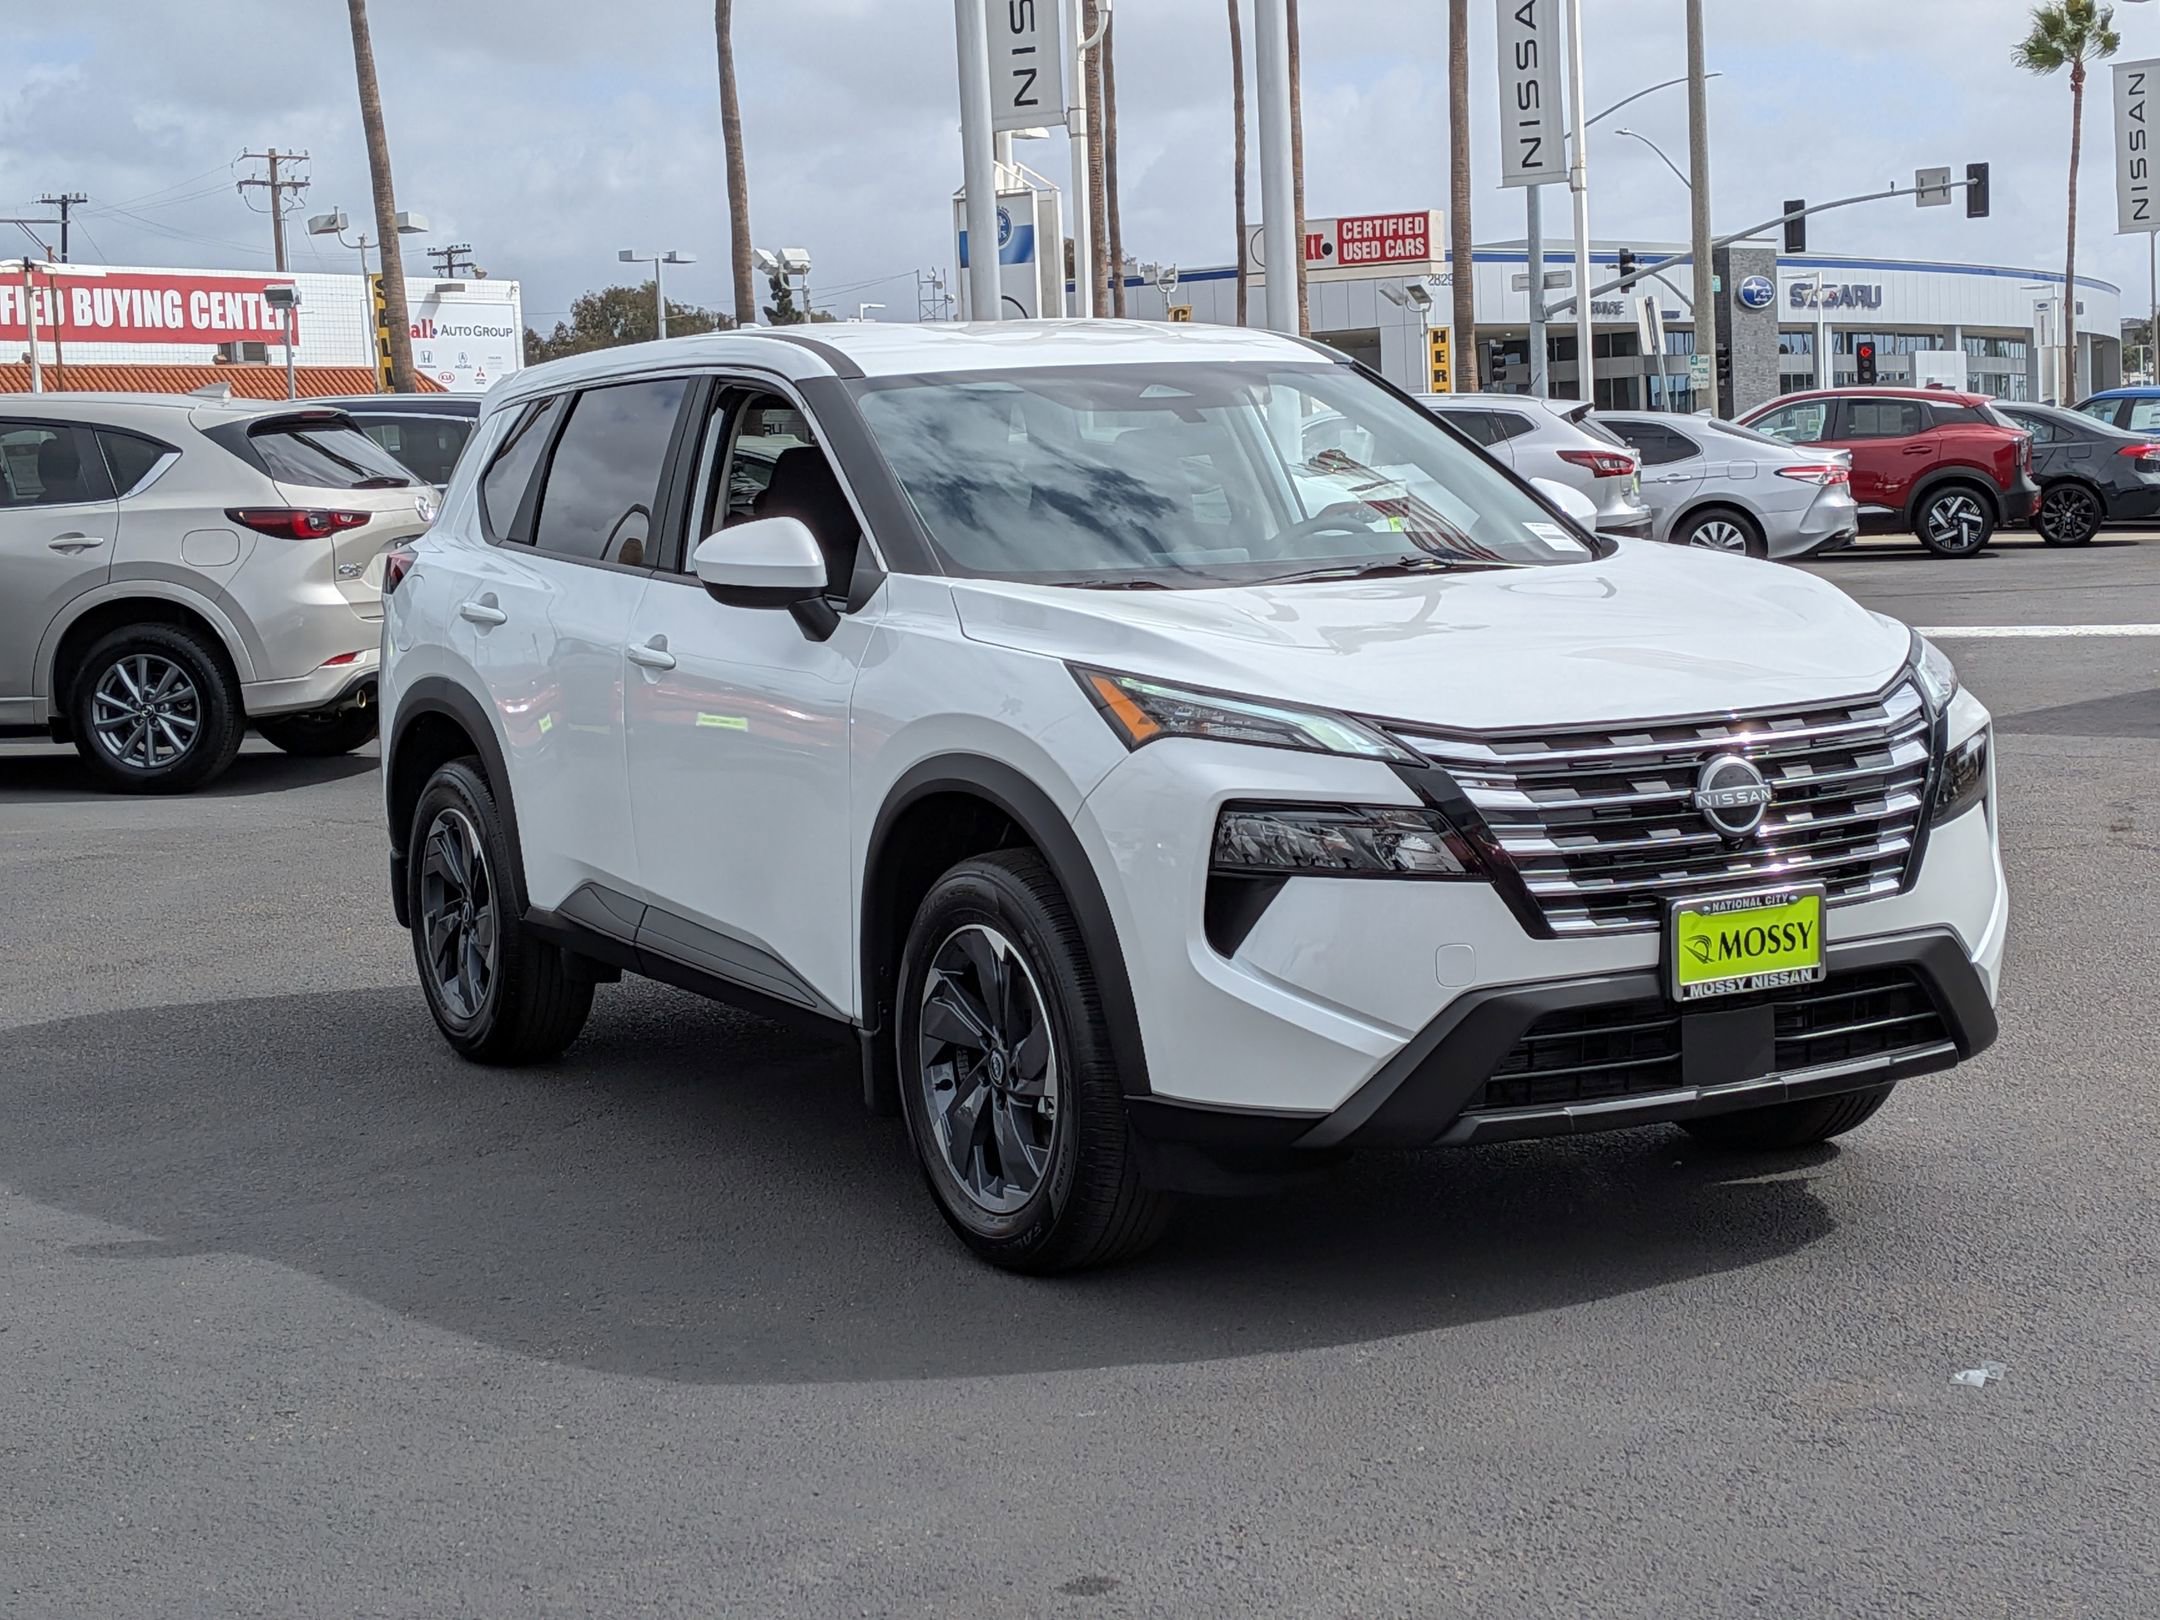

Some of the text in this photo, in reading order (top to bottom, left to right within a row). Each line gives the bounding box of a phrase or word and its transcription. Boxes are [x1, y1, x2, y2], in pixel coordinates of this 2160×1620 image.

[1515, 0, 1543, 168] NISSA
[2128, 73, 2150, 221] NISSAN
[1342, 217, 1425, 240] CERTIFIED
[1343, 238, 1425, 261] USED CARS
[71, 288, 184, 329] BUYING
[441, 324, 472, 337] AUTO
[473, 325, 514, 338] GROUP
[1432, 330, 1448, 393] HER
[1698, 789, 1772, 807] NISSAN
[1712, 894, 1789, 912] NATIONAL CITY
[1718, 919, 1813, 961] MOSSY
[1689, 968, 1812, 998] MOSSY NISSAN
